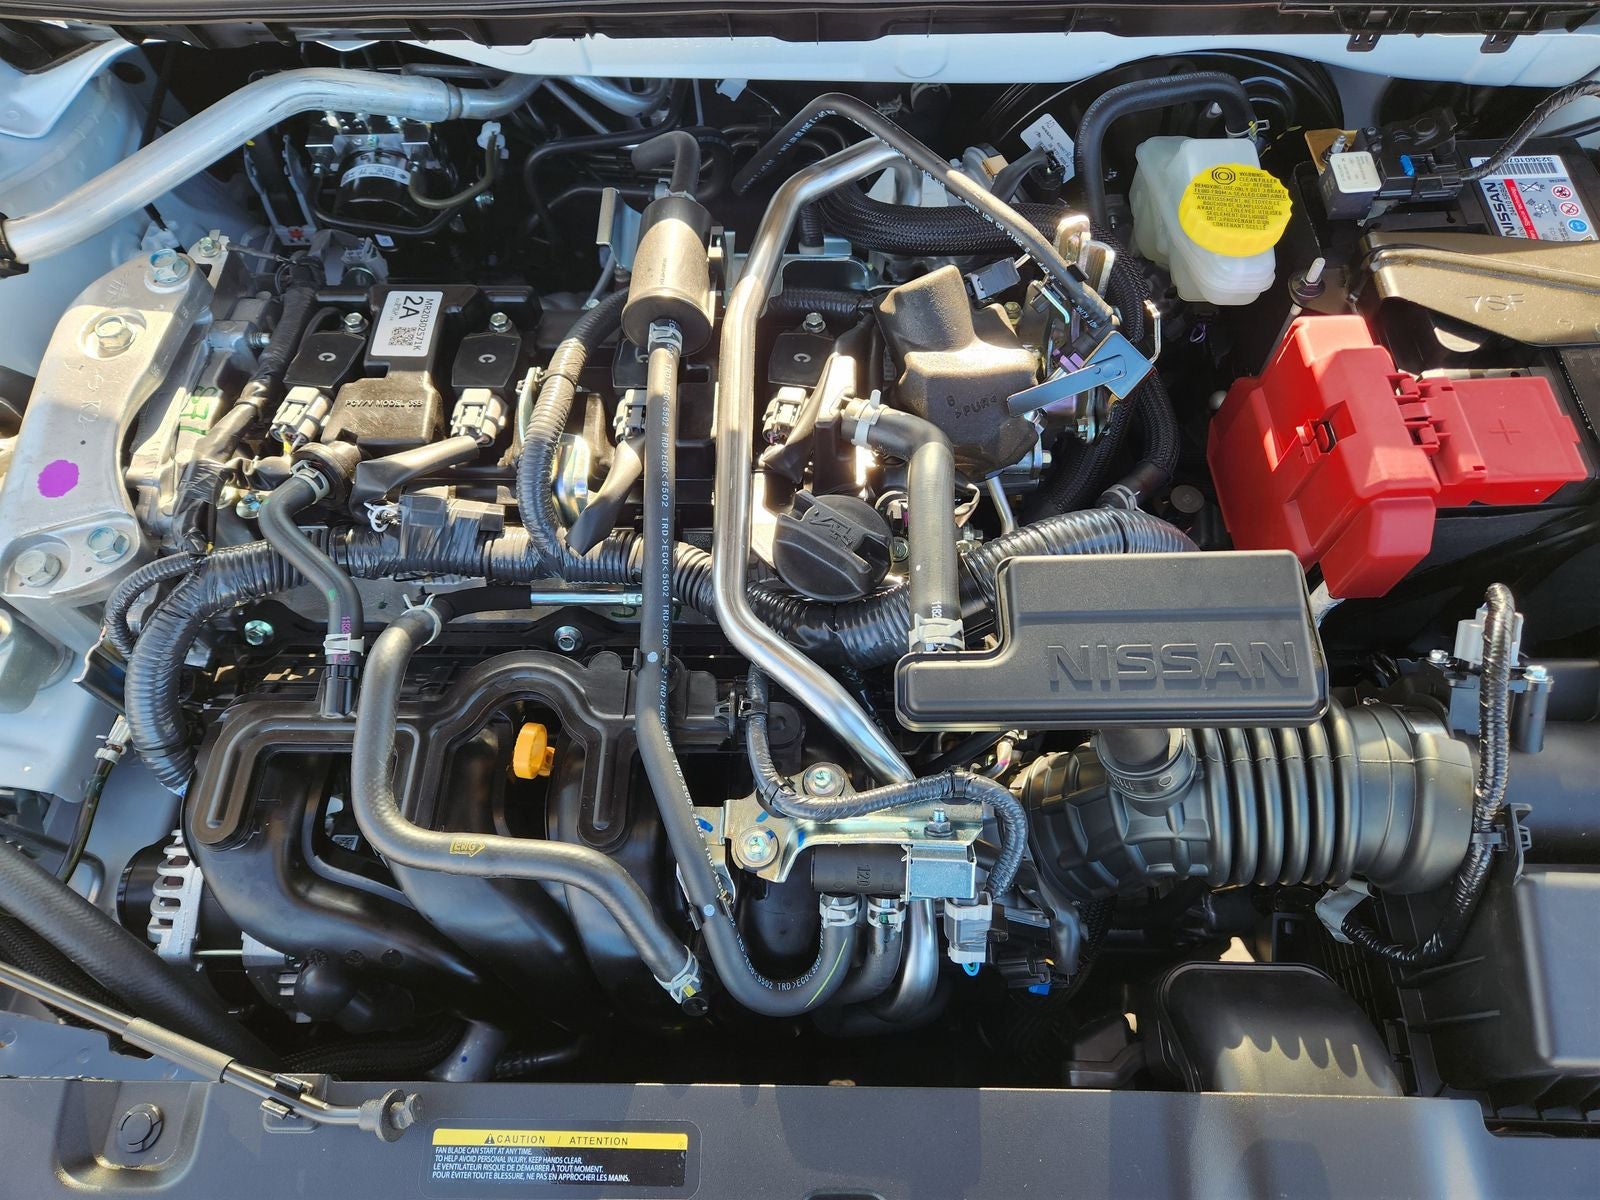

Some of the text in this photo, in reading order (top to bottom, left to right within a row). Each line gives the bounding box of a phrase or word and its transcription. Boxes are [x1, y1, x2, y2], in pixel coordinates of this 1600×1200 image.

[1484, 182, 1517, 236] NISSAN
[399, 295, 424, 320] 2A
[1047, 641, 1299, 690] NISSAN
[496, 1135, 546, 1144] CAUTION
[569, 1136, 628, 1145] ATTENTION
[435, 1154, 443, 1162] TO
[477, 1155, 506, 1163] PERSONAL
[441, 1163, 482, 1171] VENTILATEUR
[483, 1163, 505, 1172] RISQUE
[432, 1171, 451, 1179] POUR
[558, 1173, 595, 1181] APPROCHER
[596, 1173, 608, 1181] LES
